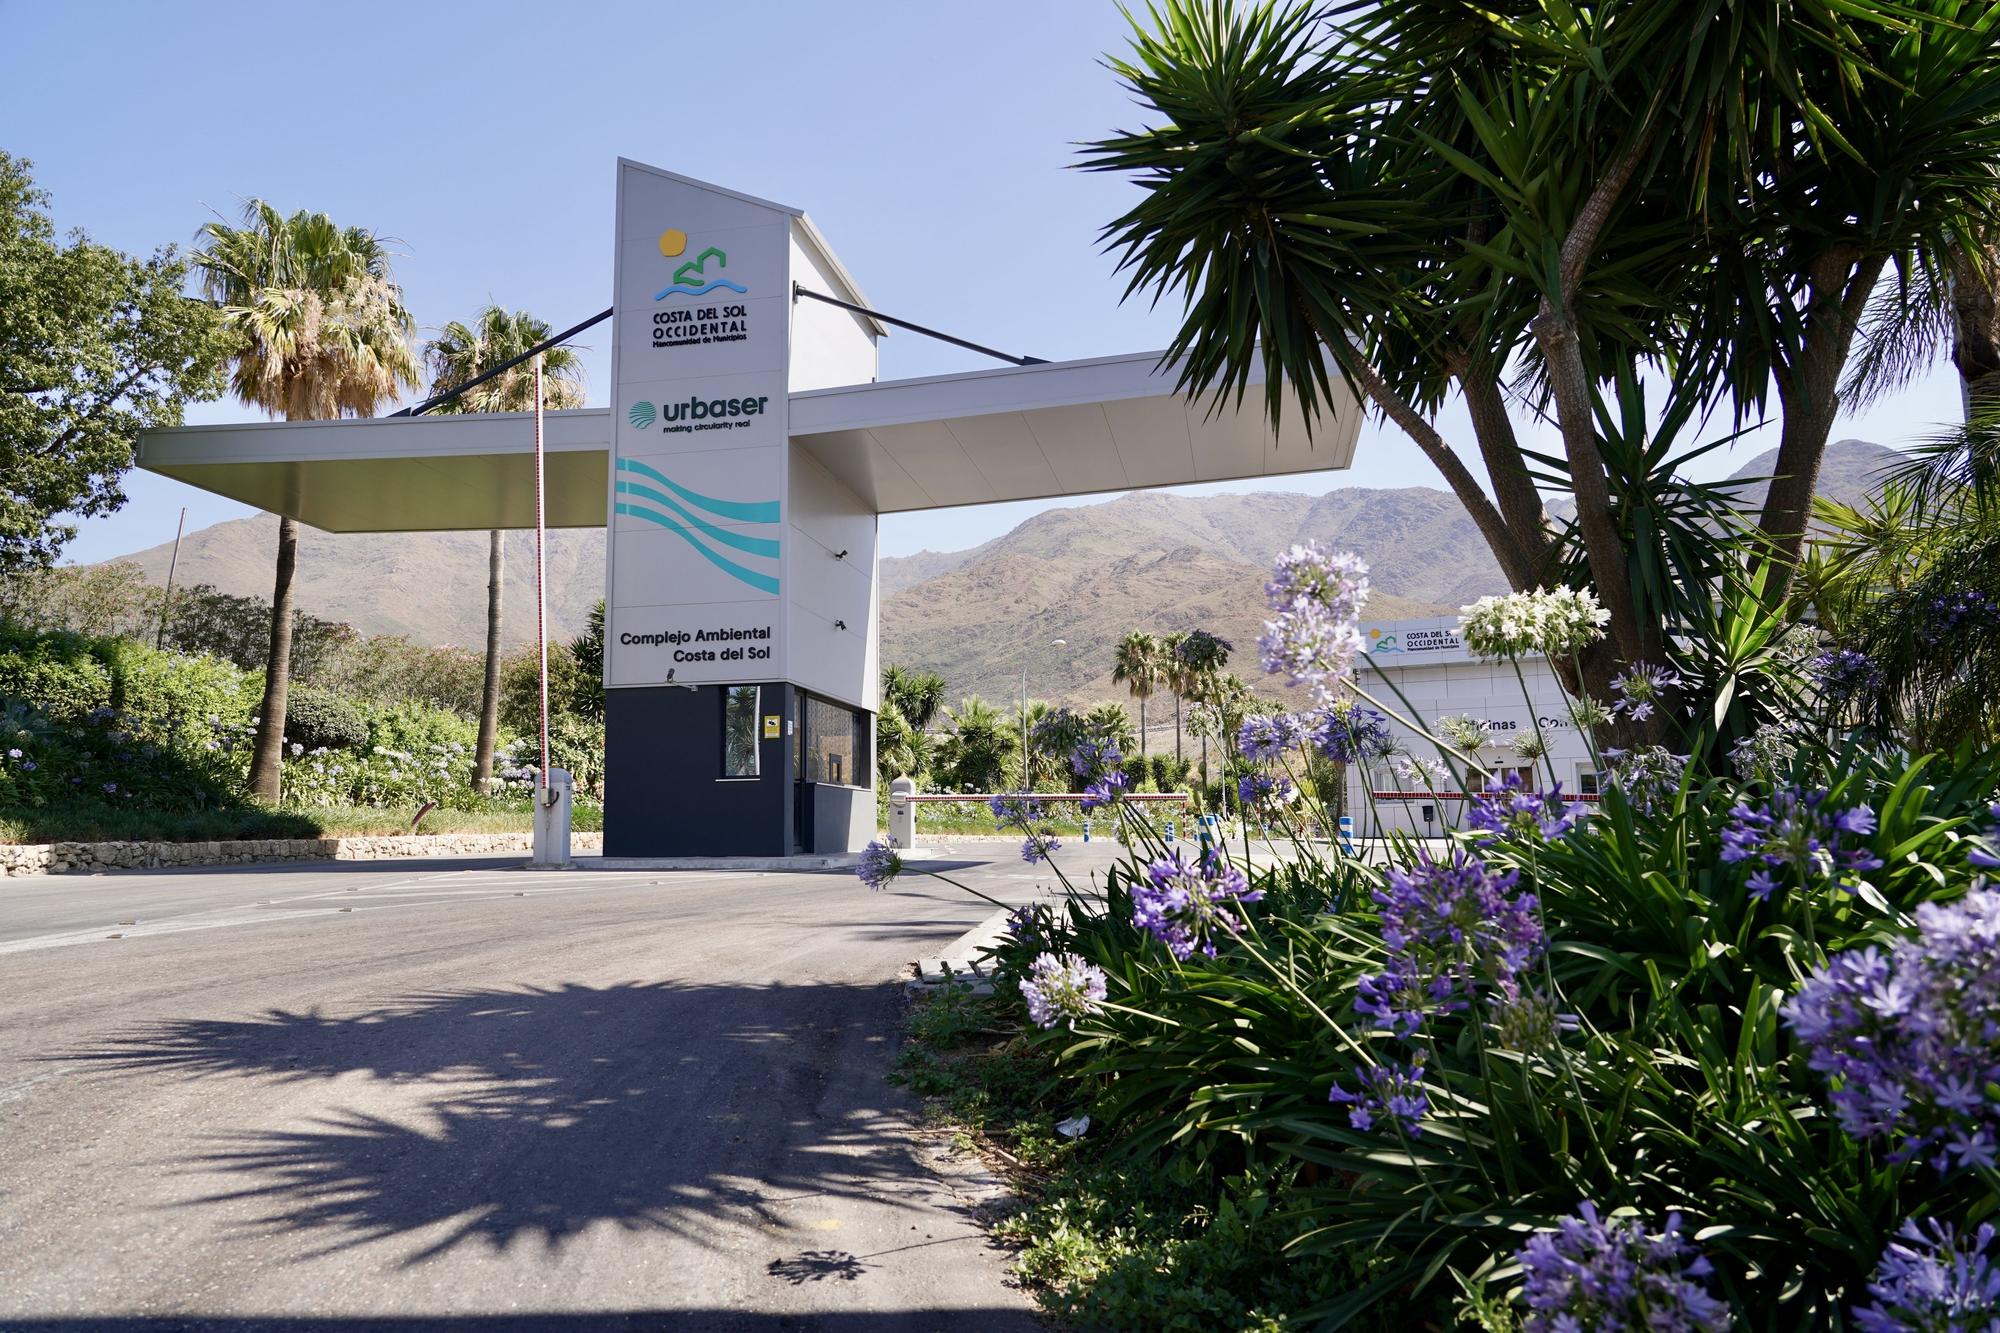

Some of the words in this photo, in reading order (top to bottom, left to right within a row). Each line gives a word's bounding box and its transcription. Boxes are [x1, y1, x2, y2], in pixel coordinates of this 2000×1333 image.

[653, 310, 693, 325] COSTA
[697, 307, 719, 321] DEL
[723, 305, 747, 318] SOL
[652, 320, 747, 339] OCCIDENTAL
[702, 336, 711, 344] de
[663, 396, 769, 422] urbaser
[663, 425, 692, 433] making
[694, 421, 733, 431] circularity
[735, 419, 751, 428] real
[620, 630, 691, 647] Complejo
[694, 626, 771, 642] Ambiental
[1406, 632, 1429, 640] COSTA
[1430, 630, 1443, 638] DEL
[1406, 637, 1460, 648] OCCIDENTAL
[673, 649, 715, 663] Costa
[720, 647, 744, 661] del
[748, 646, 771, 660] Sol
